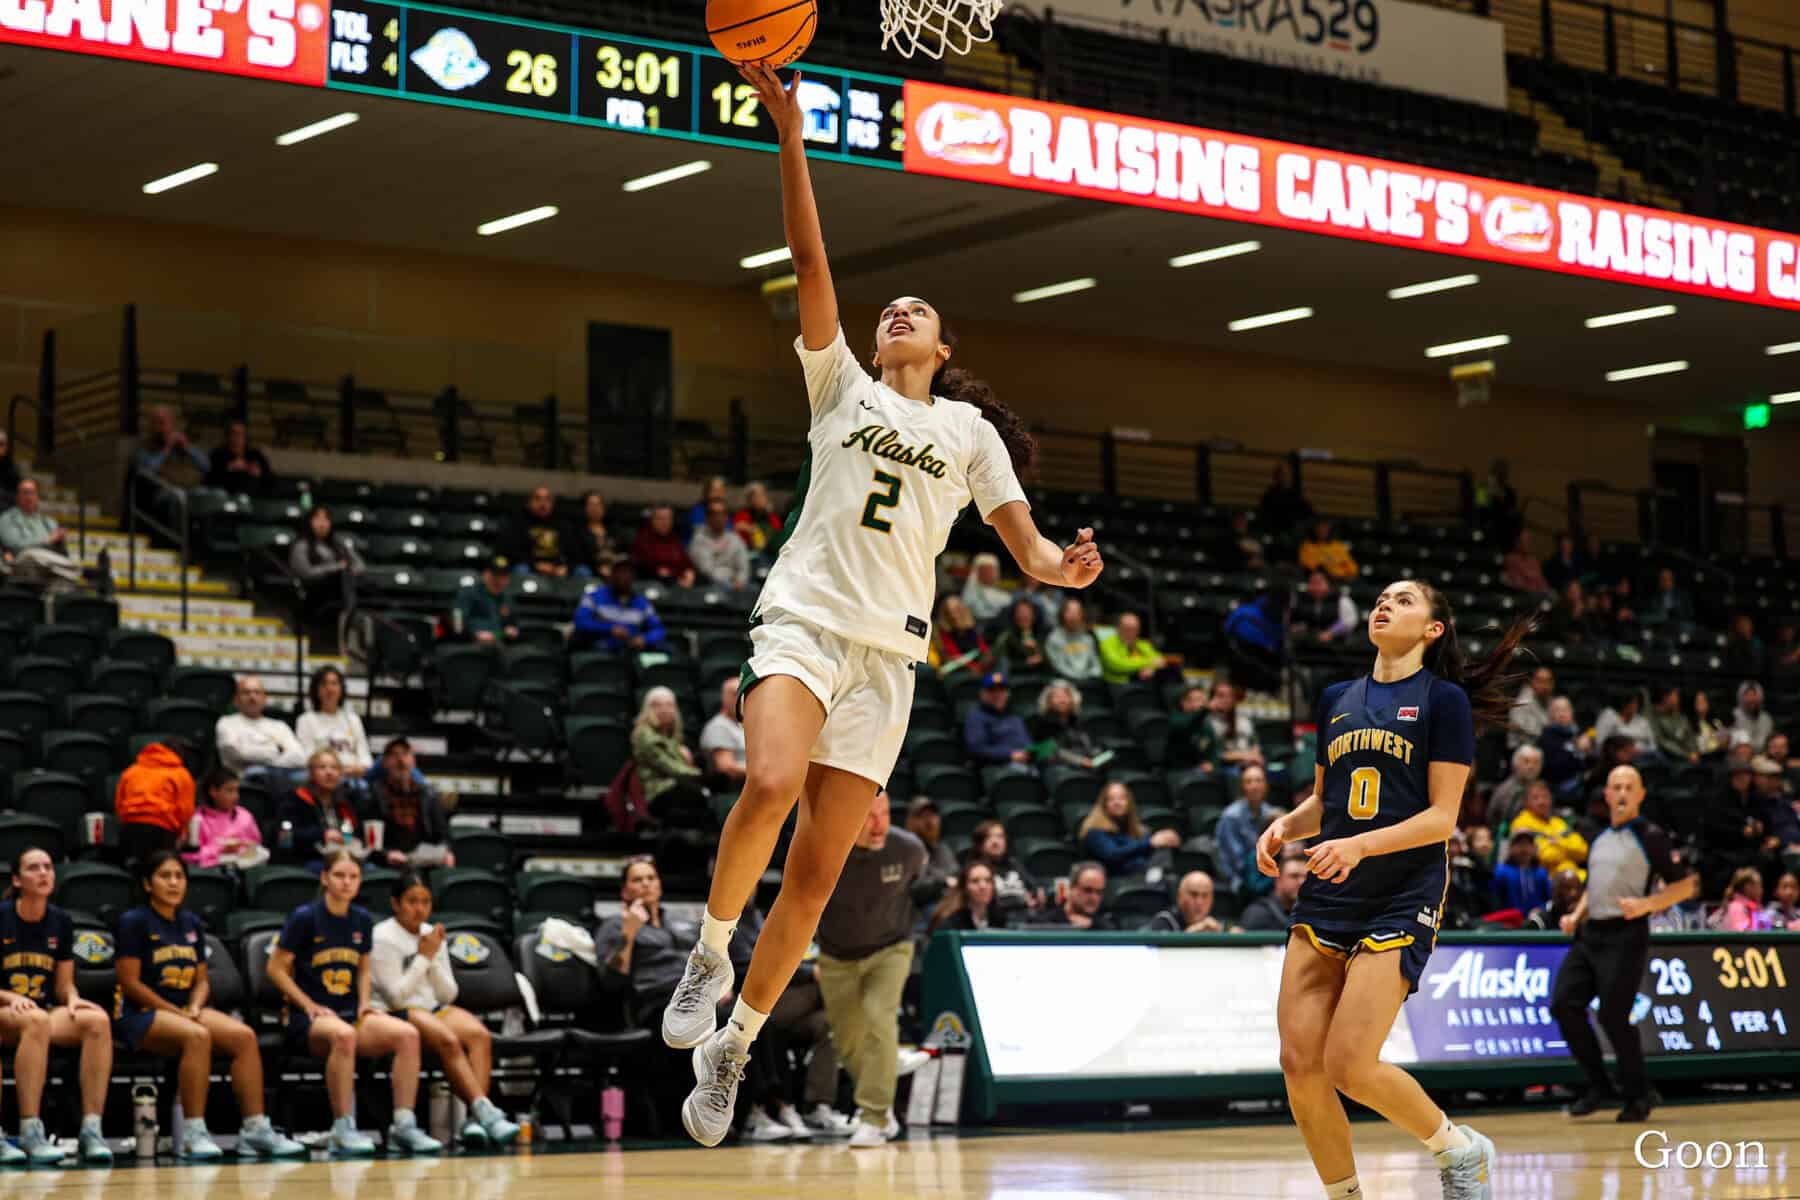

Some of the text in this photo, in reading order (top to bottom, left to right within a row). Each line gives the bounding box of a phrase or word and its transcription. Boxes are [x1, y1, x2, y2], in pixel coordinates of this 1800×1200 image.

[332, 9, 398, 43] TOL 4
[382, 51, 398, 77] 4
[505, 49, 558, 97] 26
[596, 46, 681, 98] 3:01
[647, 105, 660, 132] 1
[711, 81, 760, 128] 12
[1008, 107, 1260, 212] RAISING
[1276, 153, 1470, 245] CANE'S
[1557, 201, 1756, 294] RAISING
[1767, 239, 1800, 301] C
[842, 424, 948, 480] Alaska
[860, 469, 903, 535] 2
[1327, 728, 1414, 767] NORTHWEST
[1347, 766, 1382, 820] 0
[1428, 949, 1550, 1004] Alaska
[1650, 957, 1692, 995] 26
[1712, 947, 1787, 988] 3:01
[1447, 1005, 1553, 1027] AIRLINES
[1652, 999, 1713, 1026] FLS 4
[1730, 1008, 1787, 1036] PER 1
[1474, 1036, 1545, 1056] CENTER
[1658, 1025, 1721, 1051] TOL 4
